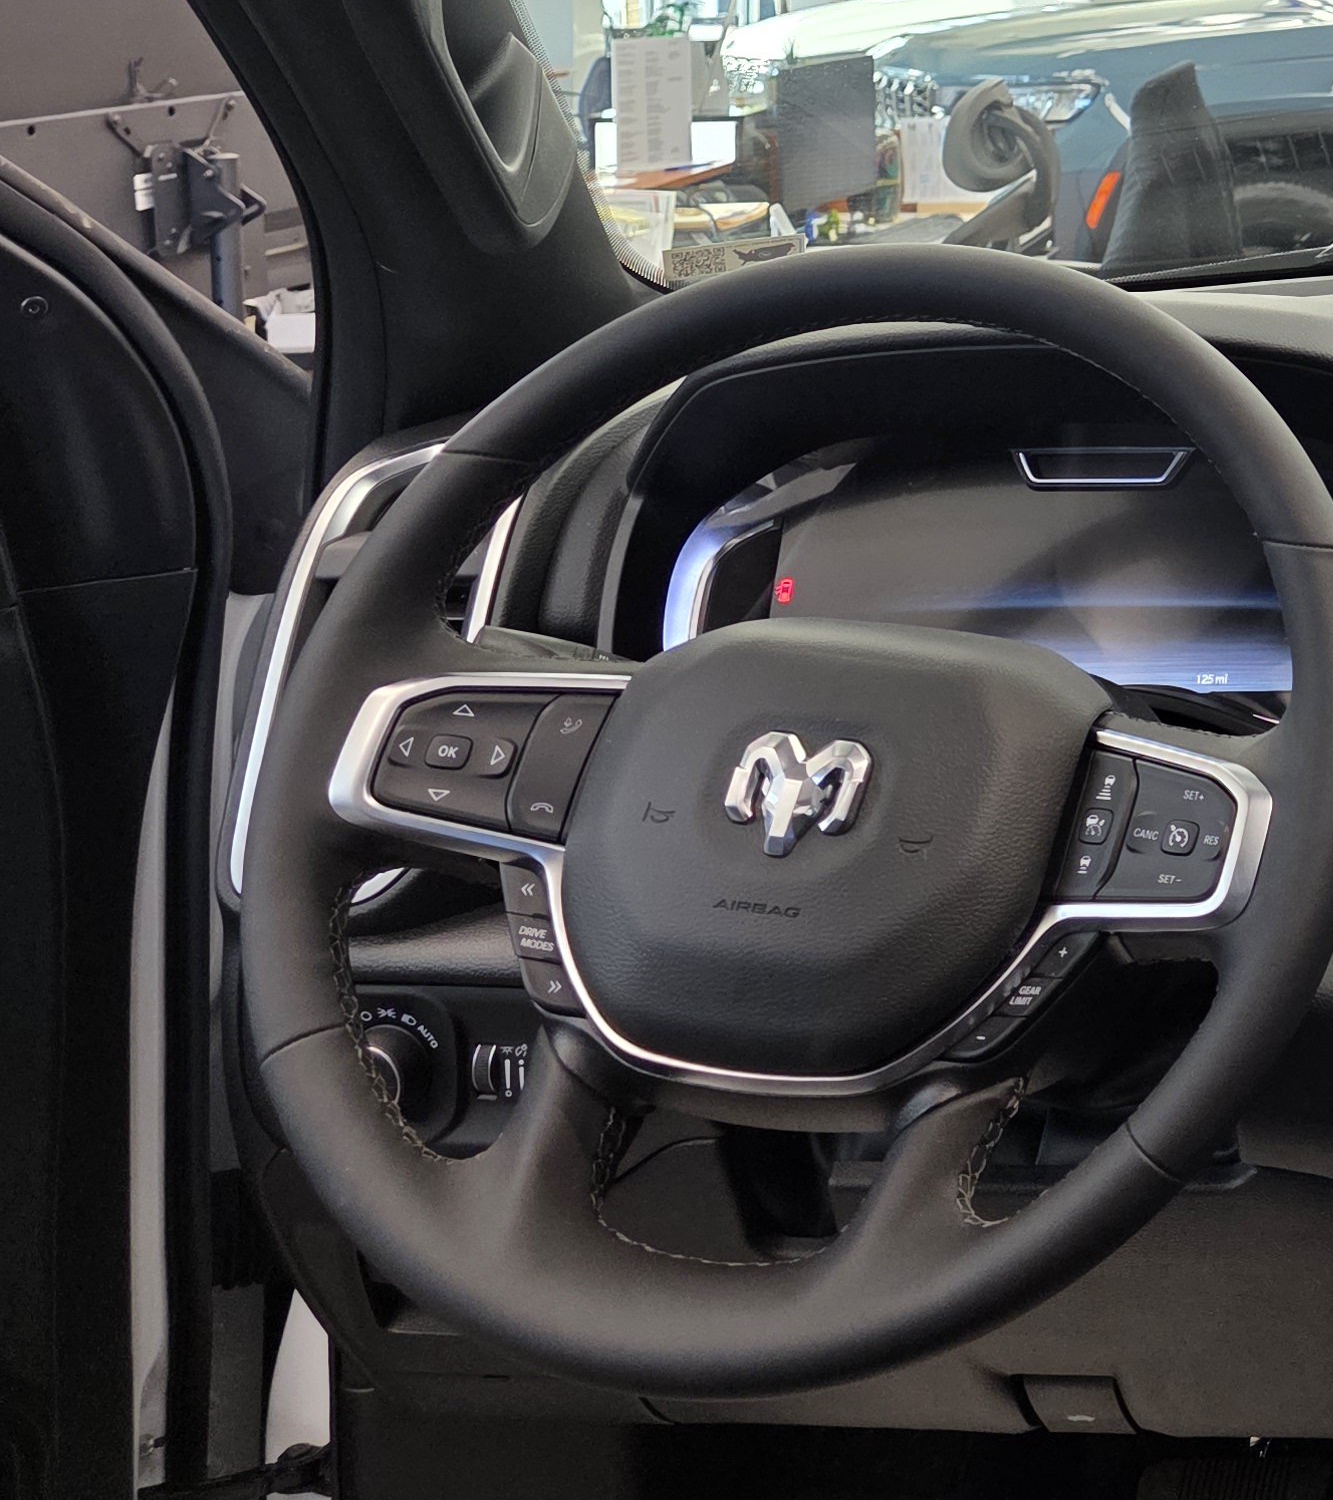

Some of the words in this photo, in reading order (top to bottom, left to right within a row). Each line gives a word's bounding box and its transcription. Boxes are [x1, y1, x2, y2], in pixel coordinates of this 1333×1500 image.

[1196, 673, 1214, 685] 125
[1215, 673, 1228, 685] mi
[438, 745, 458, 758] OK
[1133, 827, 1160, 842] CANC
[1203, 834, 1220, 847] RES
[712, 899, 802, 918] AIRBAG
[518, 925, 548, 939] DRIVE
[520, 937, 555, 952] MODES
[1019, 985, 1042, 996] GEAR
[1009, 996, 1032, 1006] LIMIT
[416, 1025, 439, 1049] AUTO
